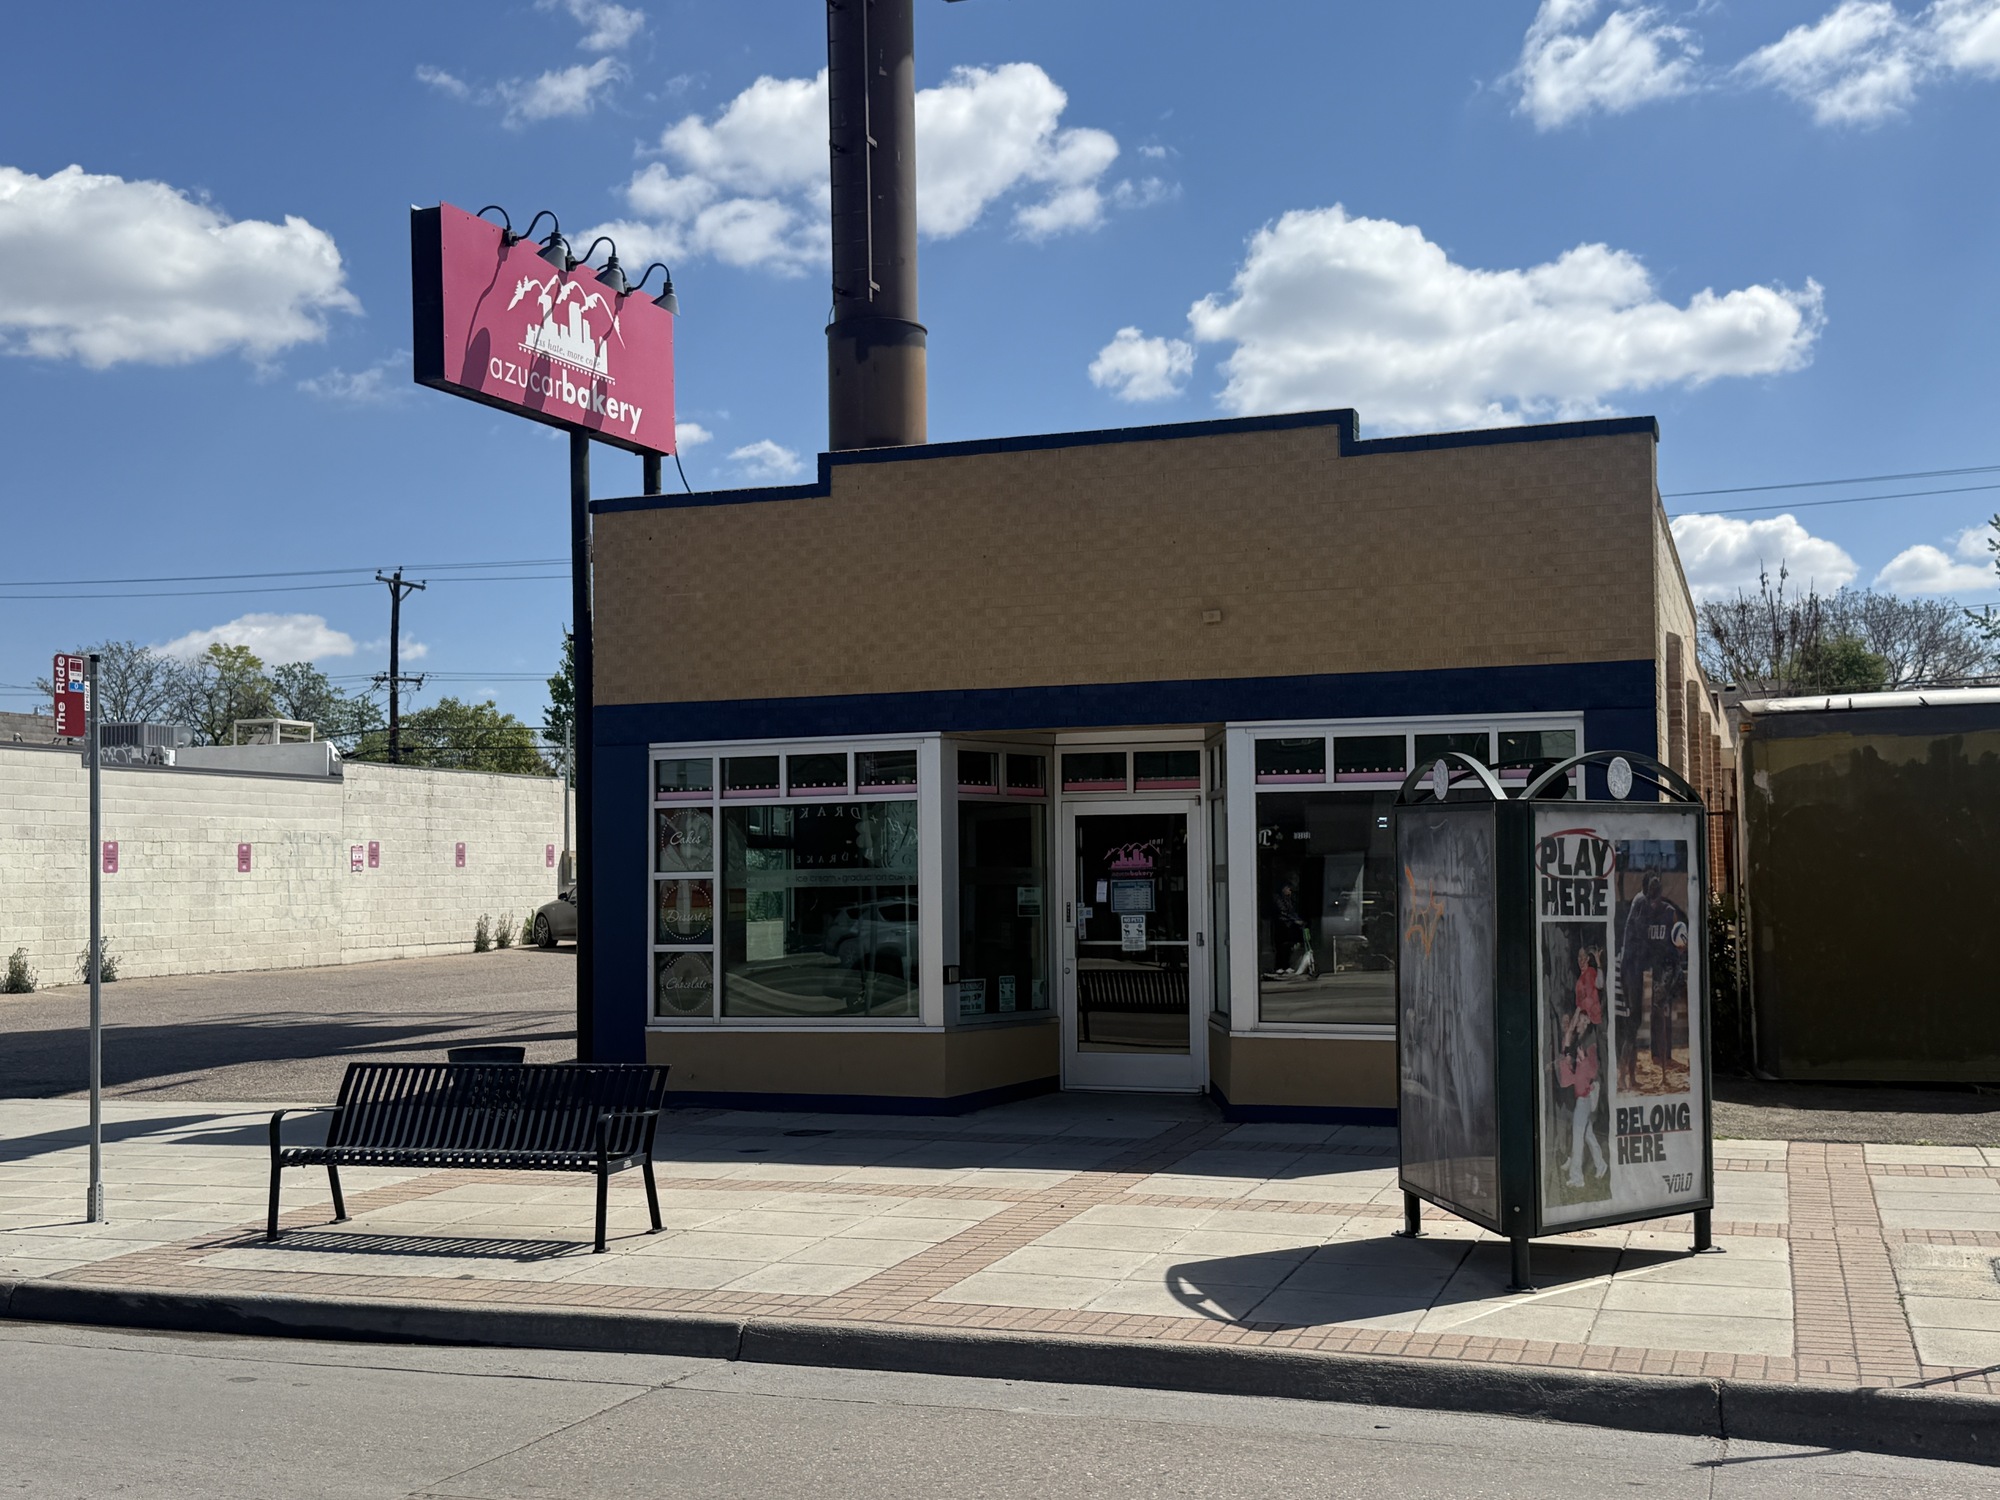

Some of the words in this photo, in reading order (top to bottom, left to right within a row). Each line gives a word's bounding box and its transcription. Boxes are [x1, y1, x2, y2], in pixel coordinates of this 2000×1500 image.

[566, 350, 584, 362] more
[489, 357, 643, 435] azucarbakery
[55, 656, 66, 694] Ride
[56, 702, 66, 733] The
[669, 830, 702, 846] Cakes
[1540, 837, 1610, 877] PLAY
[842, 874, 887, 883] graduaon
[1540, 877, 1609, 916] HERE
[665, 909, 707, 923] Desserts
[665, 977, 709, 990] Chocolate
[1616, 1103, 1691, 1135] BELONG
[1616, 1132, 1667, 1165] HERE
[1662, 1172, 1693, 1194] VOLO
